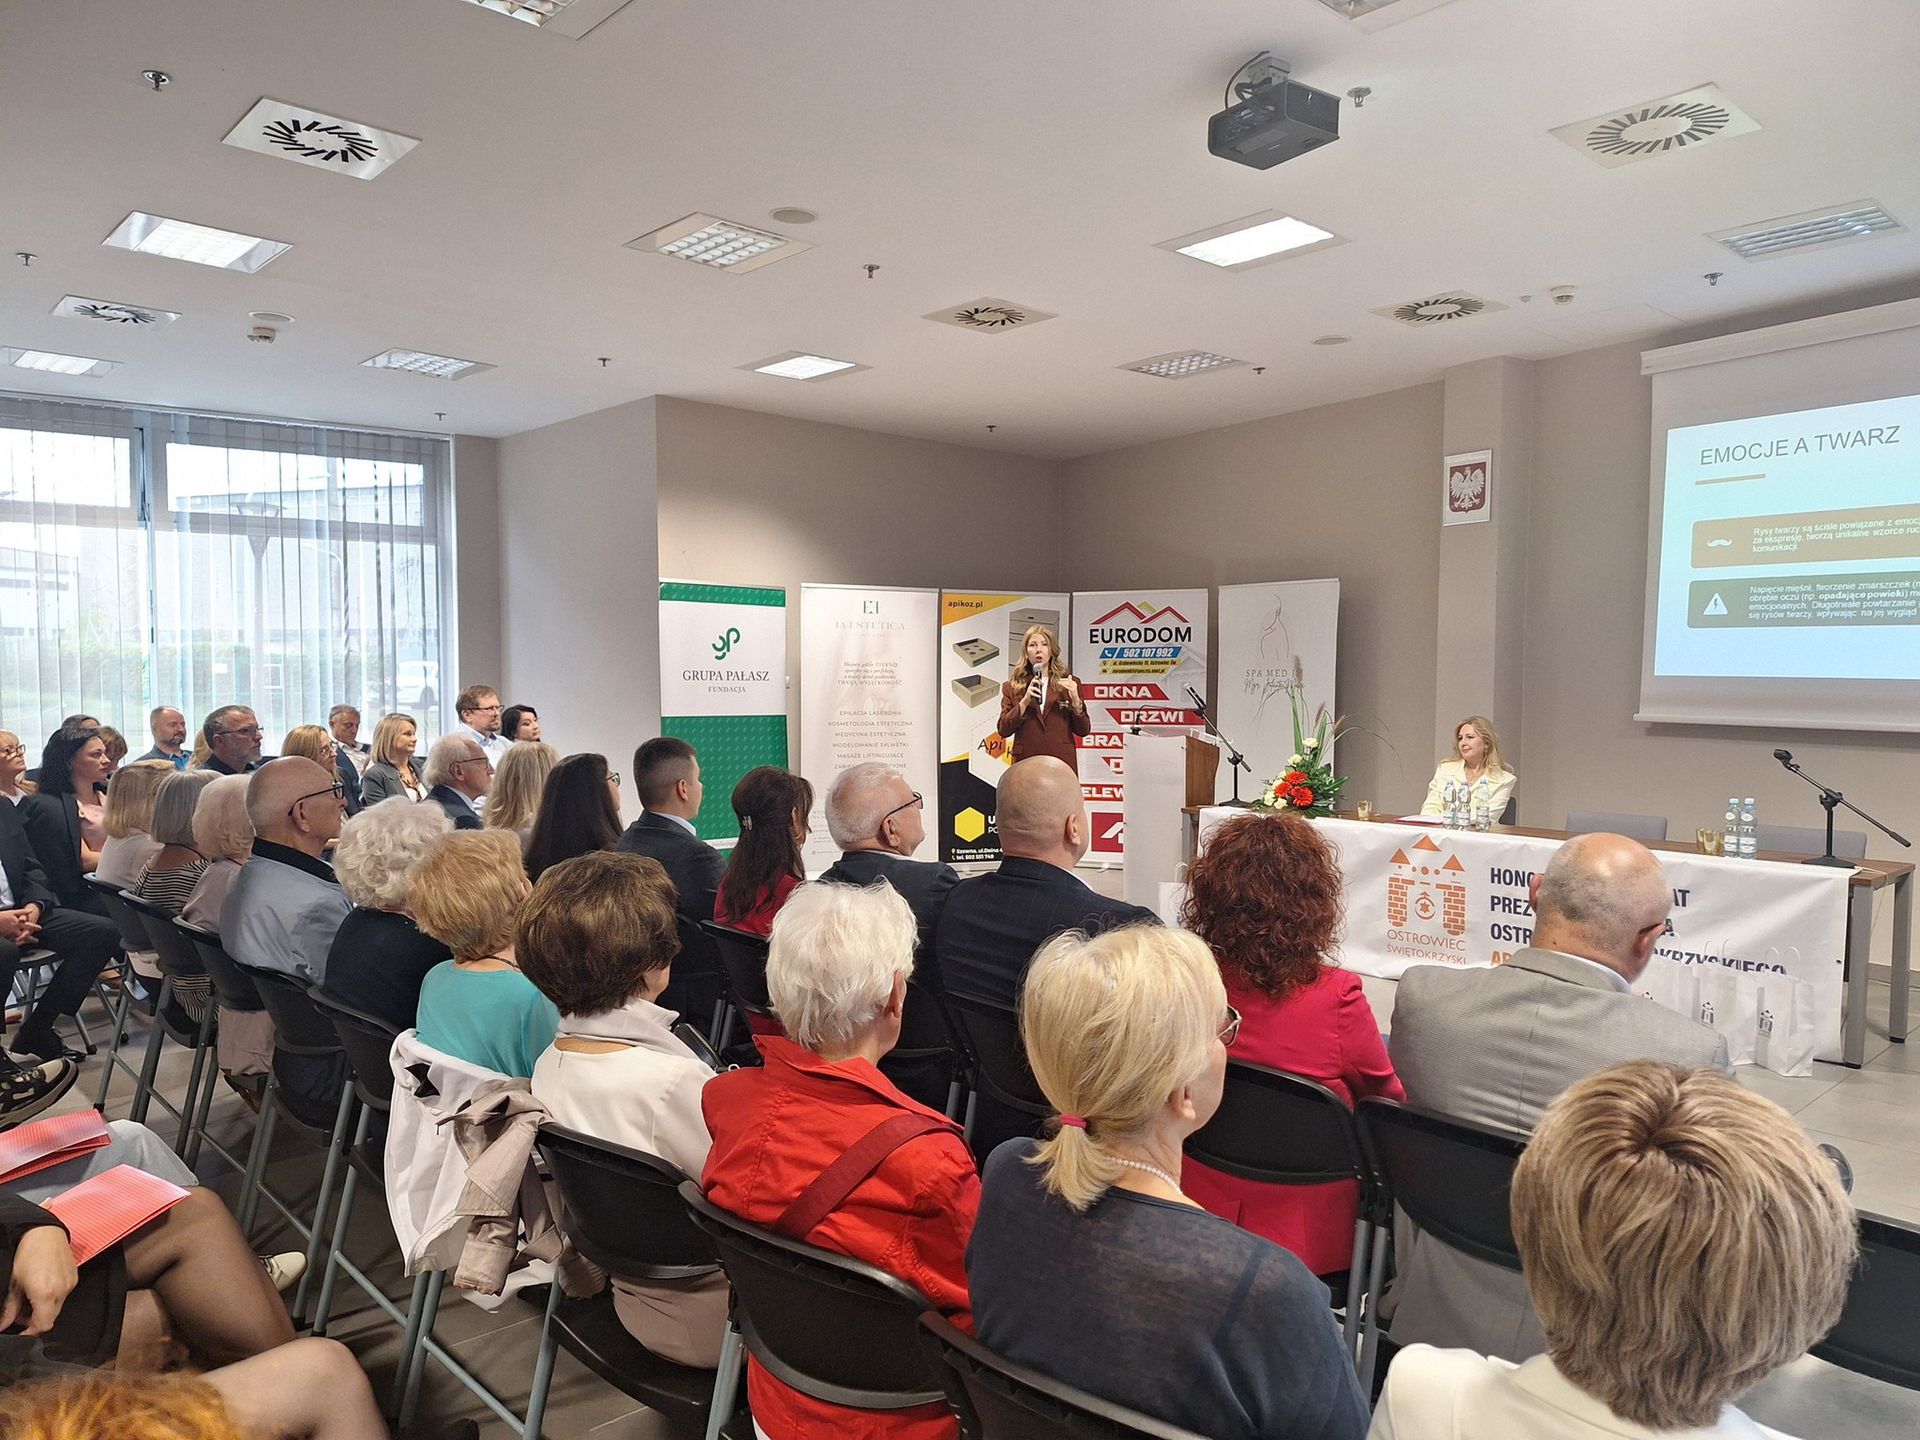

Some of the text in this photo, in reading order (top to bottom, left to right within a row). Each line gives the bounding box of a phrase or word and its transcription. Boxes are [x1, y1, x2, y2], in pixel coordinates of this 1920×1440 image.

[1701, 425, 1900, 465] EMOCJE A TWARZ
[1754, 528, 1774, 537] Rysy
[1774, 526, 1800, 535] twarzy
[1840, 520, 1884, 531] powiązane
[1816, 583, 1856, 591] tworzenie
[1858, 580, 1911, 590] zmarszczek
[1819, 591, 1866, 601] opadające
[1867, 590, 1908, 600] powieki)
[1863, 600, 1916, 609] powtarzanie
[1887, 608, 1917, 618] wygląd
[1090, 627, 1192, 644] EURODOM
[1123, 648, 1173, 657] 502 107 992
[682, 670, 770, 681] GRUPA PAŁASZ
[1246, 669, 1262, 677] SPA
[1266, 669, 1287, 677] MED
[1094, 686, 1152, 698] OKNA
[1120, 711, 1184, 722] DRZWI
[977, 737, 1003, 755] Api
[1082, 735, 1123, 746] BRA
[1081, 787, 1123, 798] ELEW
[1490, 868, 1534, 887] HON
[1490, 896, 1533, 917] PREZ
[1490, 923, 1533, 944] OSTR
[1387, 929, 1466, 951] OSTROWIEC
[1386, 944, 1466, 965] ŚWIĘTOKRZYSKI
